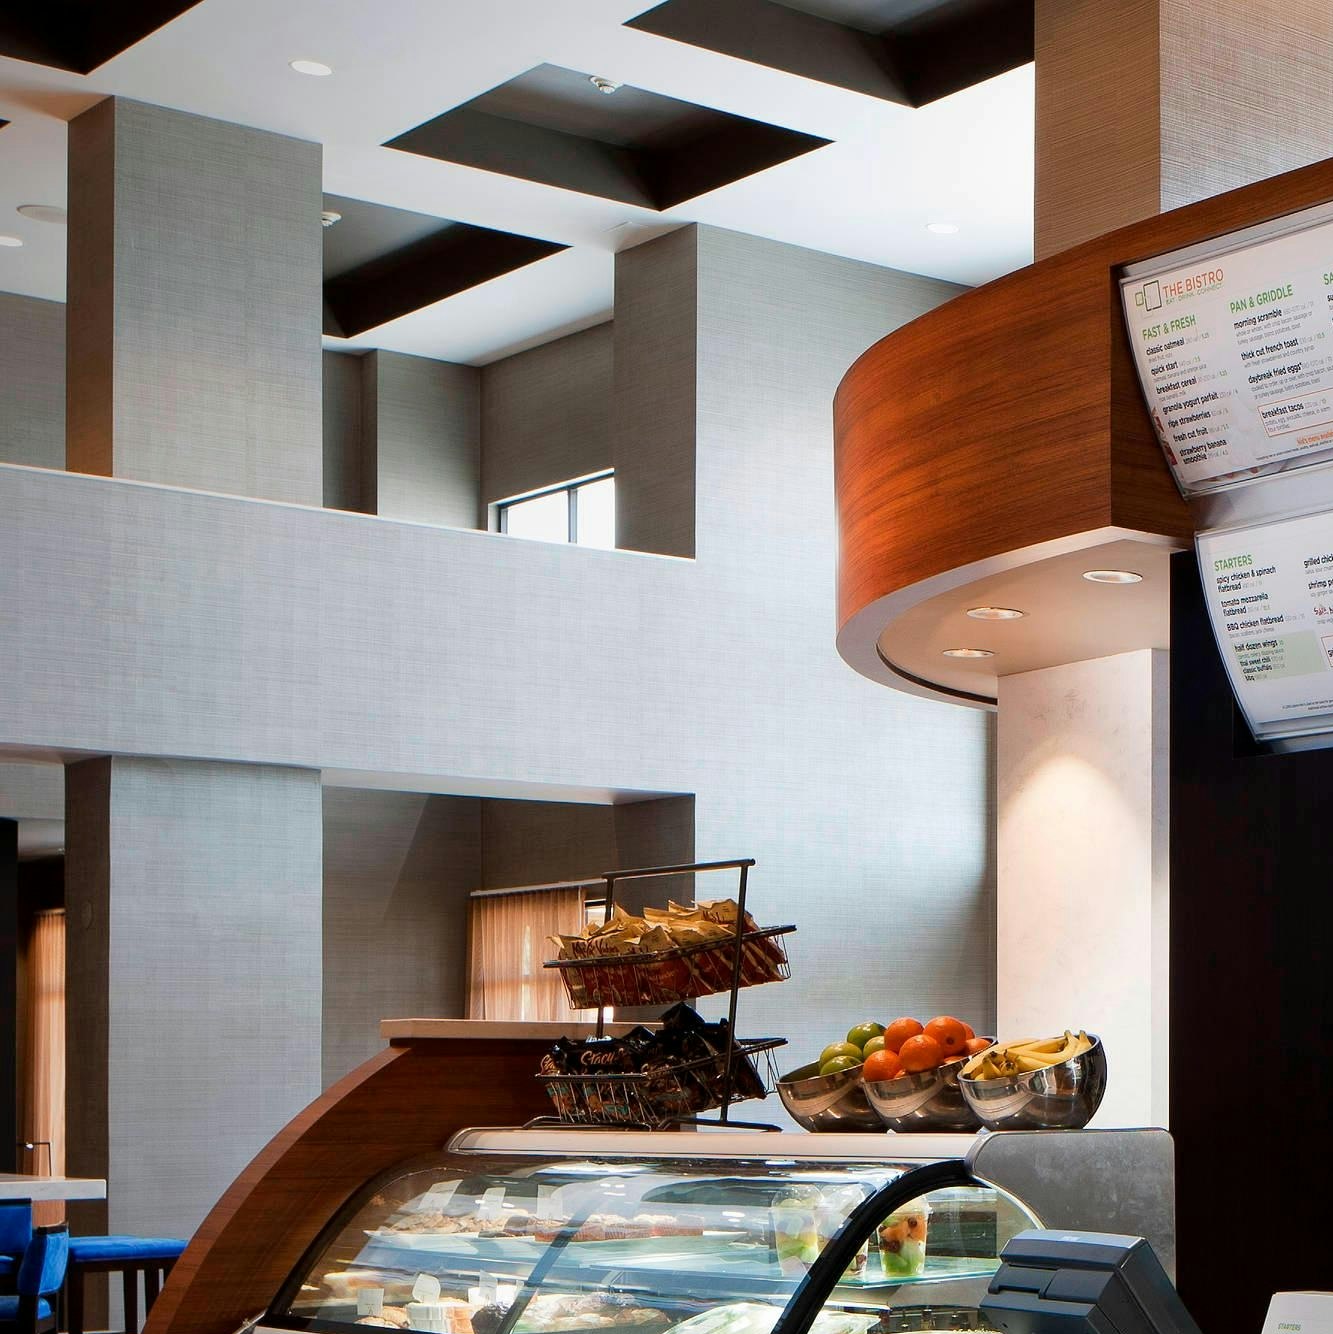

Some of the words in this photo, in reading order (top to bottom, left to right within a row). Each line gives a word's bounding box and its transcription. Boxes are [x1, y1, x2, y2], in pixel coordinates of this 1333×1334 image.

[1163, 280, 1183, 299] THE
[1185, 268, 1224, 292] BISTRO
[1229, 298, 1247, 313] PAN
[1248, 296, 1255, 308] &
[1256, 284, 1293, 305] GRIDDLE
[1142, 324, 1161, 340] FAST
[1163, 323, 1169, 334] &
[1170, 314, 1196, 332] FRESH
[1233, 317, 1257, 330] morning
[1257, 309, 1282, 322] scramble
[1146, 344, 1163, 355] classic
[1163, 337, 1184, 350] oatmeal
[1240, 350, 1255, 360] thick
[1255, 347, 1265, 357] cut
[1265, 341, 1283, 354] french
[1283, 338, 1299, 349] toast
[1151, 365, 1165, 376] quick
[1165, 361, 1178, 371] start
[1214, 554, 1253, 572] STARTERS
